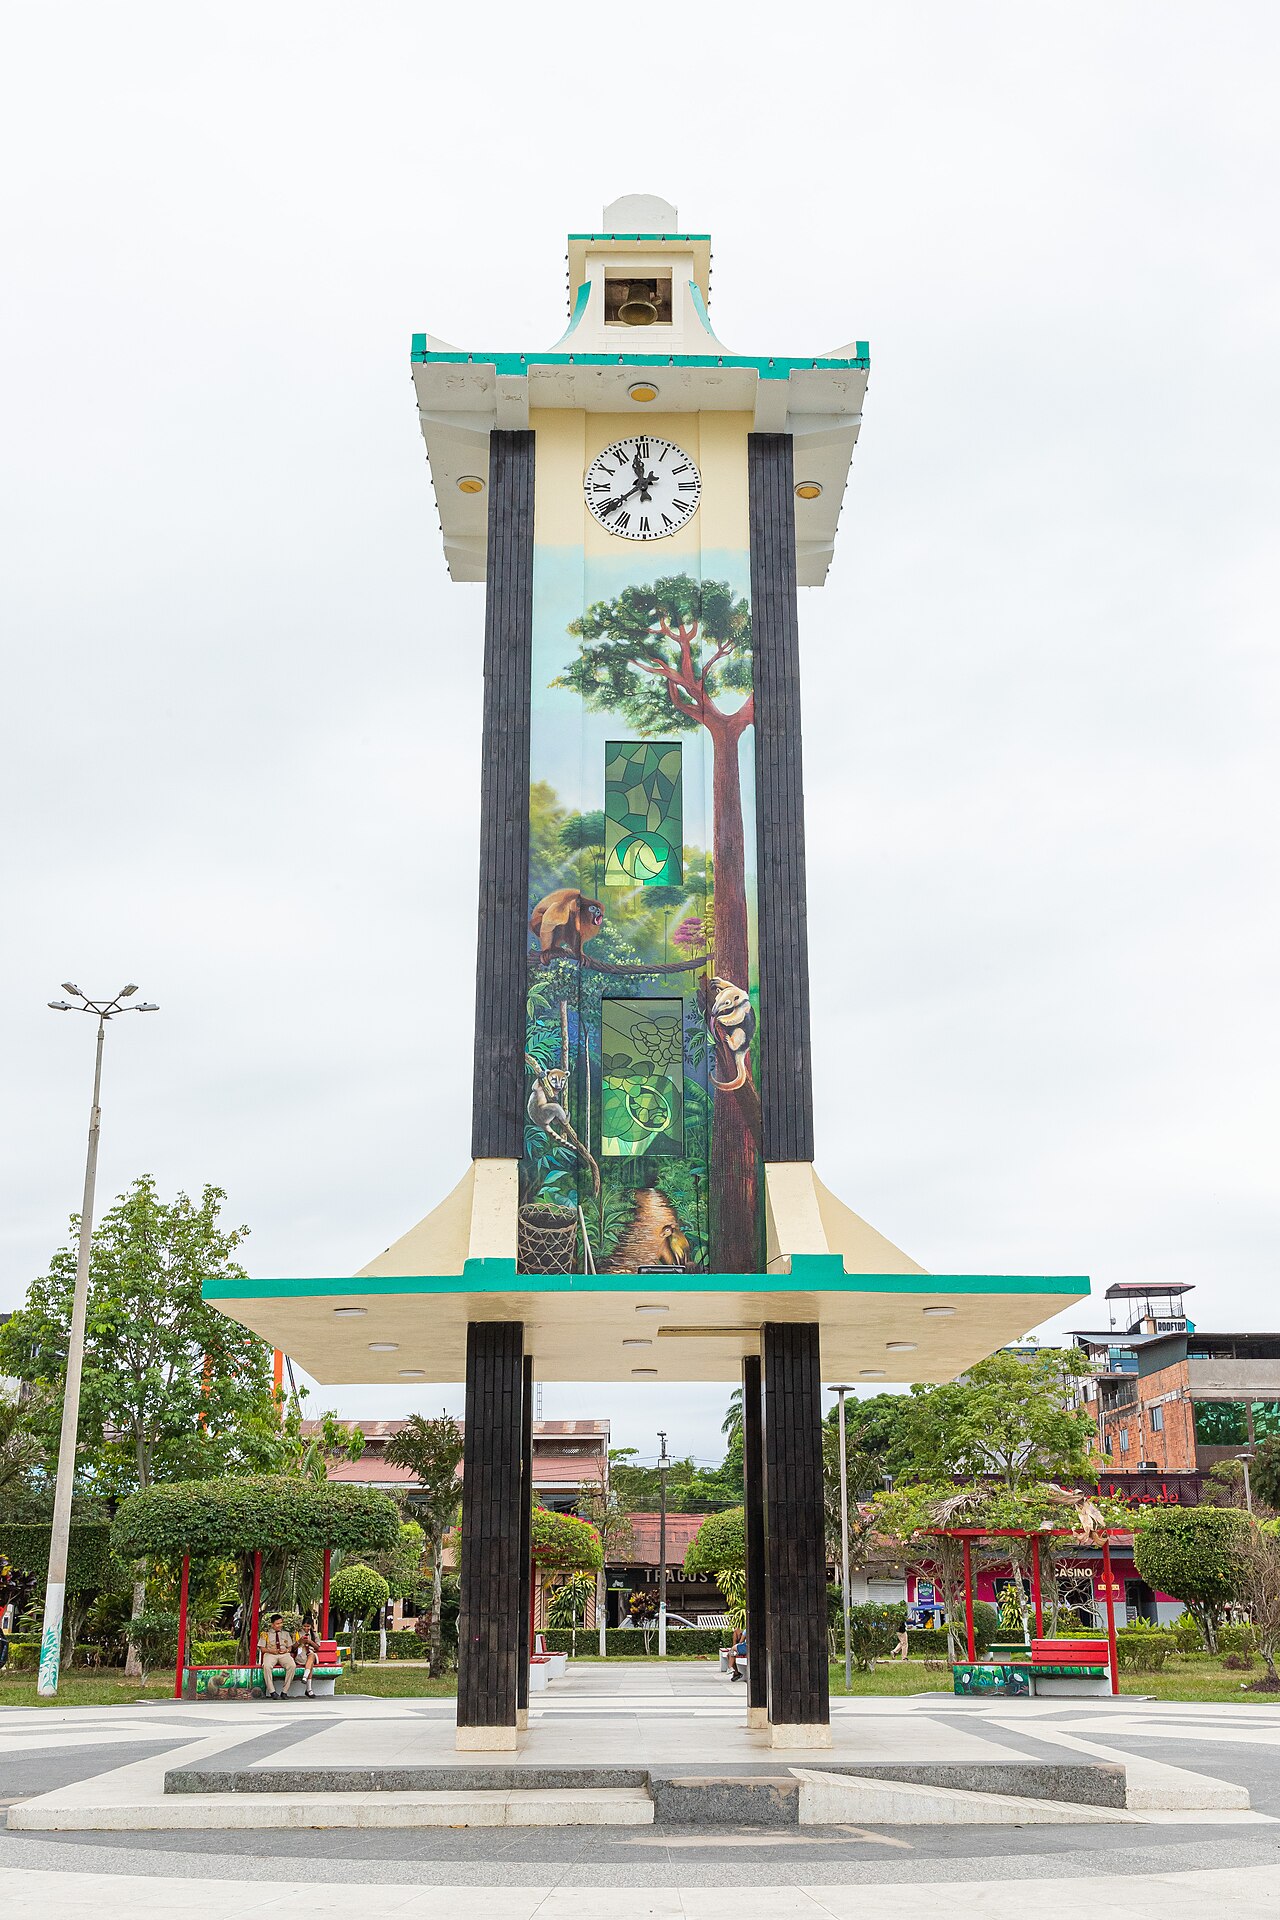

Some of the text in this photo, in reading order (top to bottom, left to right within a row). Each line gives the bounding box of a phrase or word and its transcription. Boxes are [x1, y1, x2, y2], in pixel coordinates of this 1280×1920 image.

[612, 448, 630, 466] XI
[635, 443, 650, 459] XII
[659, 448, 668, 462] I
[598, 463, 615, 476] X
[672, 464, 689, 475] II
[592, 483, 611, 492] IX
[678, 481, 696, 491] III
[672, 499, 690, 513] IV
[614, 511, 631, 529] VII
[640, 517, 650, 531] VI
[661, 513, 673, 527] V
[1157, 1321, 1186, 1332] ROOFTOP
